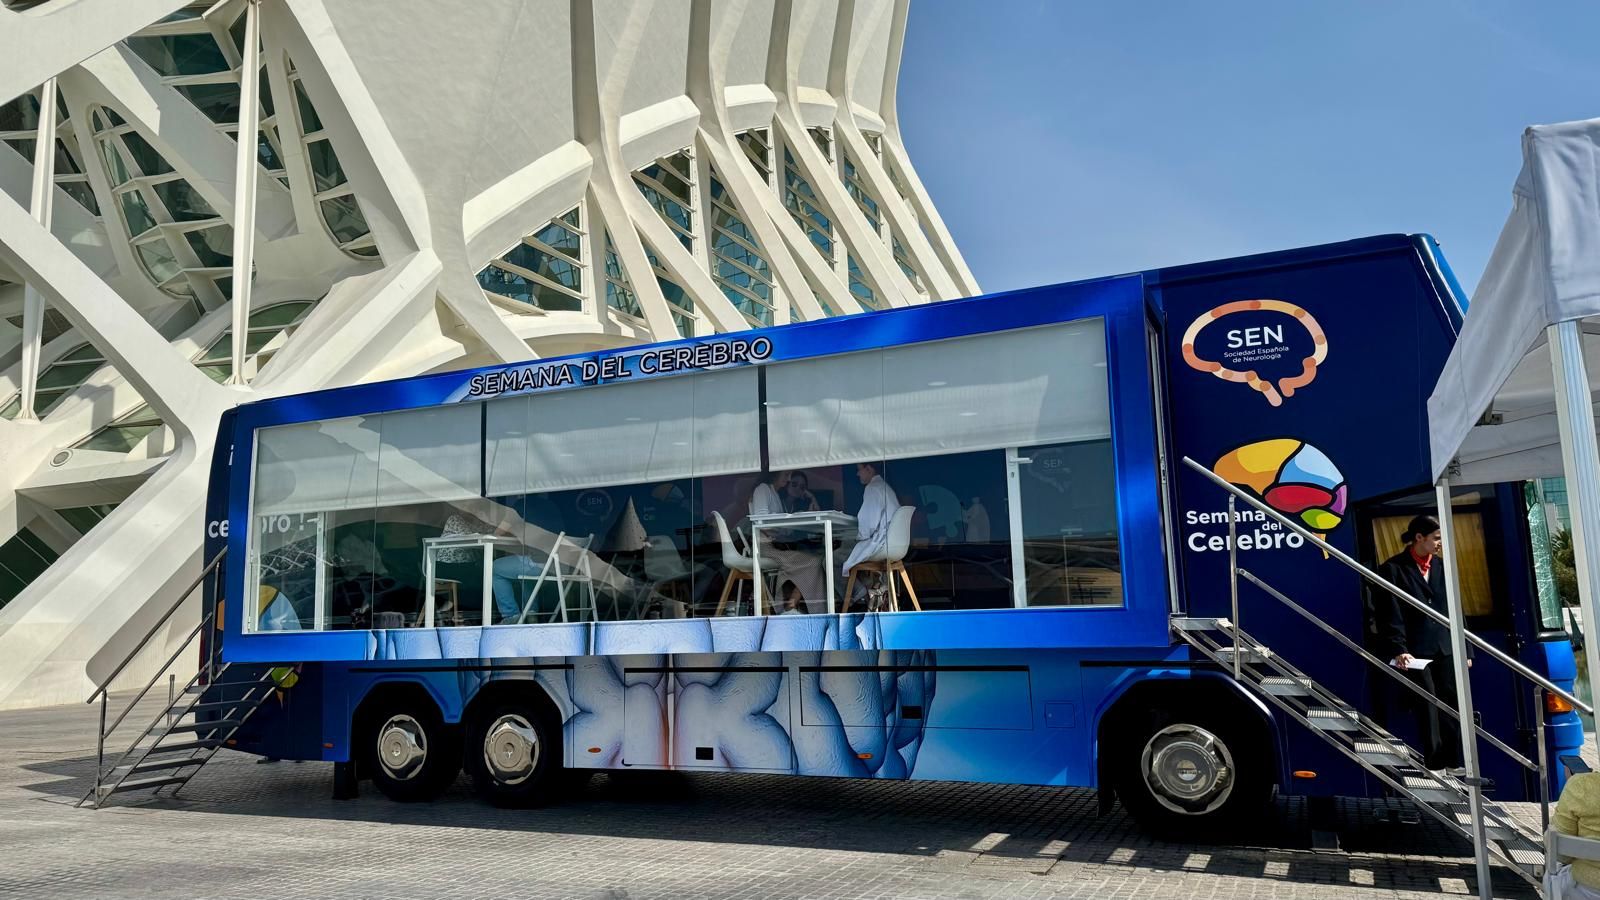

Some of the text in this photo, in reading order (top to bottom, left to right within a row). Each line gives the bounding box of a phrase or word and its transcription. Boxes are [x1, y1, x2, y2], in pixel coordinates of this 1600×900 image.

[1227, 325, 1284, 349] SEN
[1223, 346, 1290, 358] Sociedad Española
[470, 336, 772, 395] SEMANA DEL CEREBRO
[1186, 510, 1265, 525] Semana
[1261, 521, 1282, 532] del
